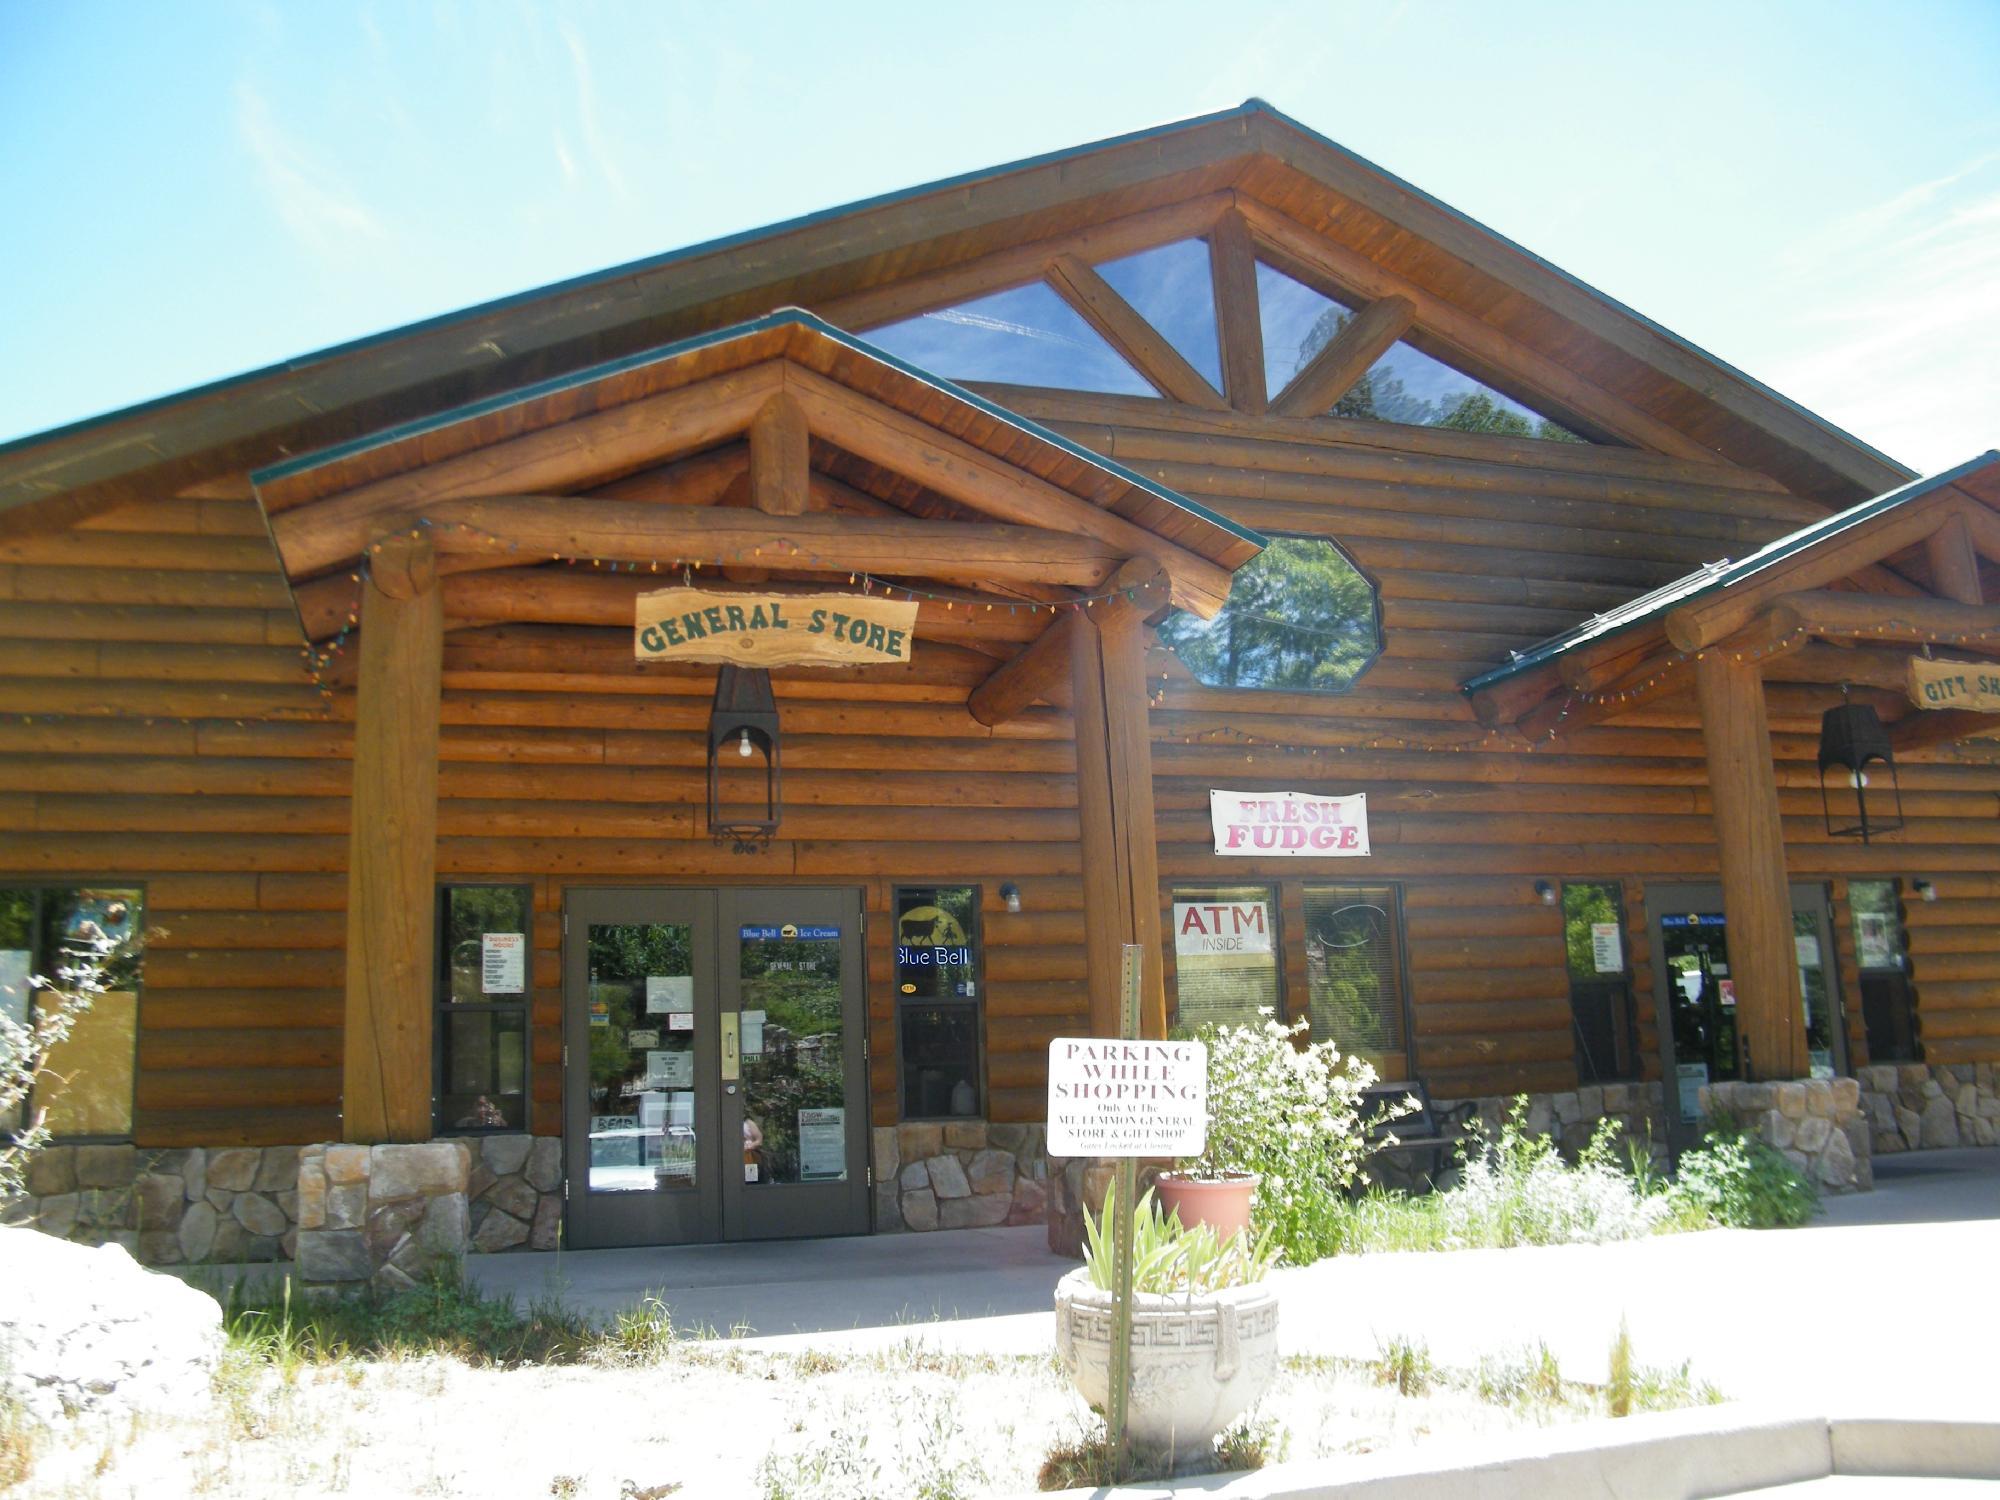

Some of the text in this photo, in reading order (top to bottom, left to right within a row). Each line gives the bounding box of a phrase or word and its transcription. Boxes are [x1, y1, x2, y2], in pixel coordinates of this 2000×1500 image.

[641, 603, 905, 657] GENERAL STORE
[1924, 675, 1967, 702] GIFT
[1239, 800, 1343, 824] FRESH
[1225, 825, 1359, 849] FUDGE
[1181, 905, 1264, 935] ATM
[743, 928, 838, 938] Blue Bell Ice Cream
[1202, 937, 1244, 951] INSIDE
[899, 947, 968, 965] Blue Bell
[1067, 1044, 1190, 1061] PARKING
[1083, 1064, 1175, 1080] WHILE
[1055, 1083, 1197, 1099] SHOPPING
[1097, 1104, 1120, 1112] Only
[1141, 1104, 1159, 1112] The
[1139, 1116, 1193, 1126] GENERAL
[1068, 1129, 1185, 1138] STORE & GIFT SHOP
